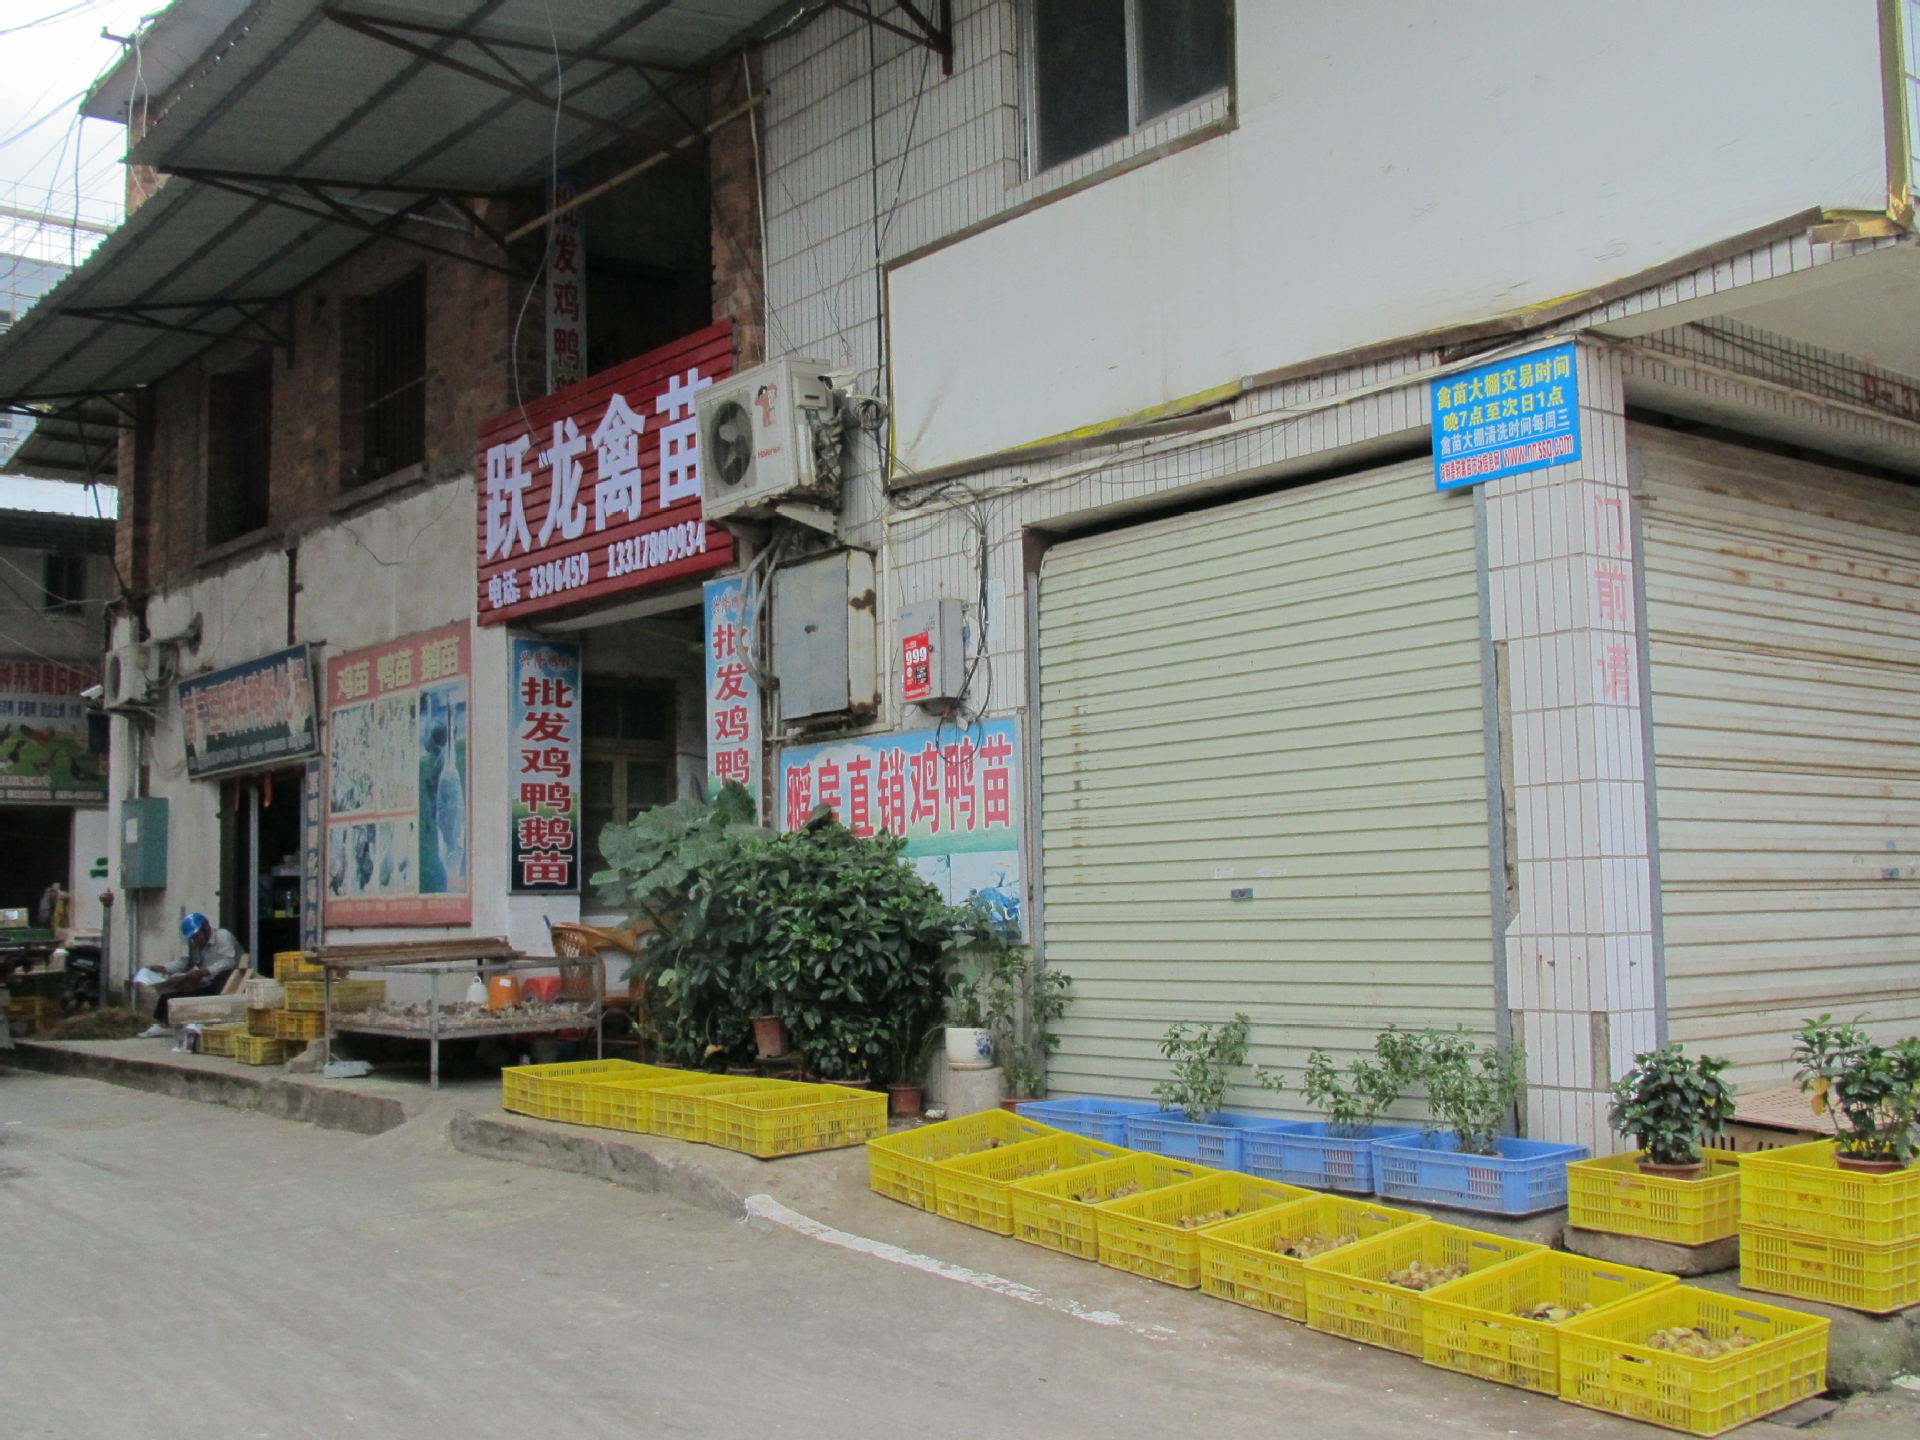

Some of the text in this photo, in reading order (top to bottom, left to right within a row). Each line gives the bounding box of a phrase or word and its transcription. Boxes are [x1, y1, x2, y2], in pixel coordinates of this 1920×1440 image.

[1437, 355, 1571, 411] 禽苗大棚交易时间
[1443, 386, 1564, 432] 晚7点至次日1点
[1441, 408, 1571, 456] 禽苗大棚清洗时间每周三
[486, 367, 713, 560] 跃龙禽苗
[488, 568, 520, 609] 电话
[1594, 494, 1631, 701] 门前请
[905, 646, 928, 666] 999
[519, 676, 573, 886] 批发鸡鸭鹅苗
[785, 732, 1013, 840] 孵房直销鸡鸭苗
